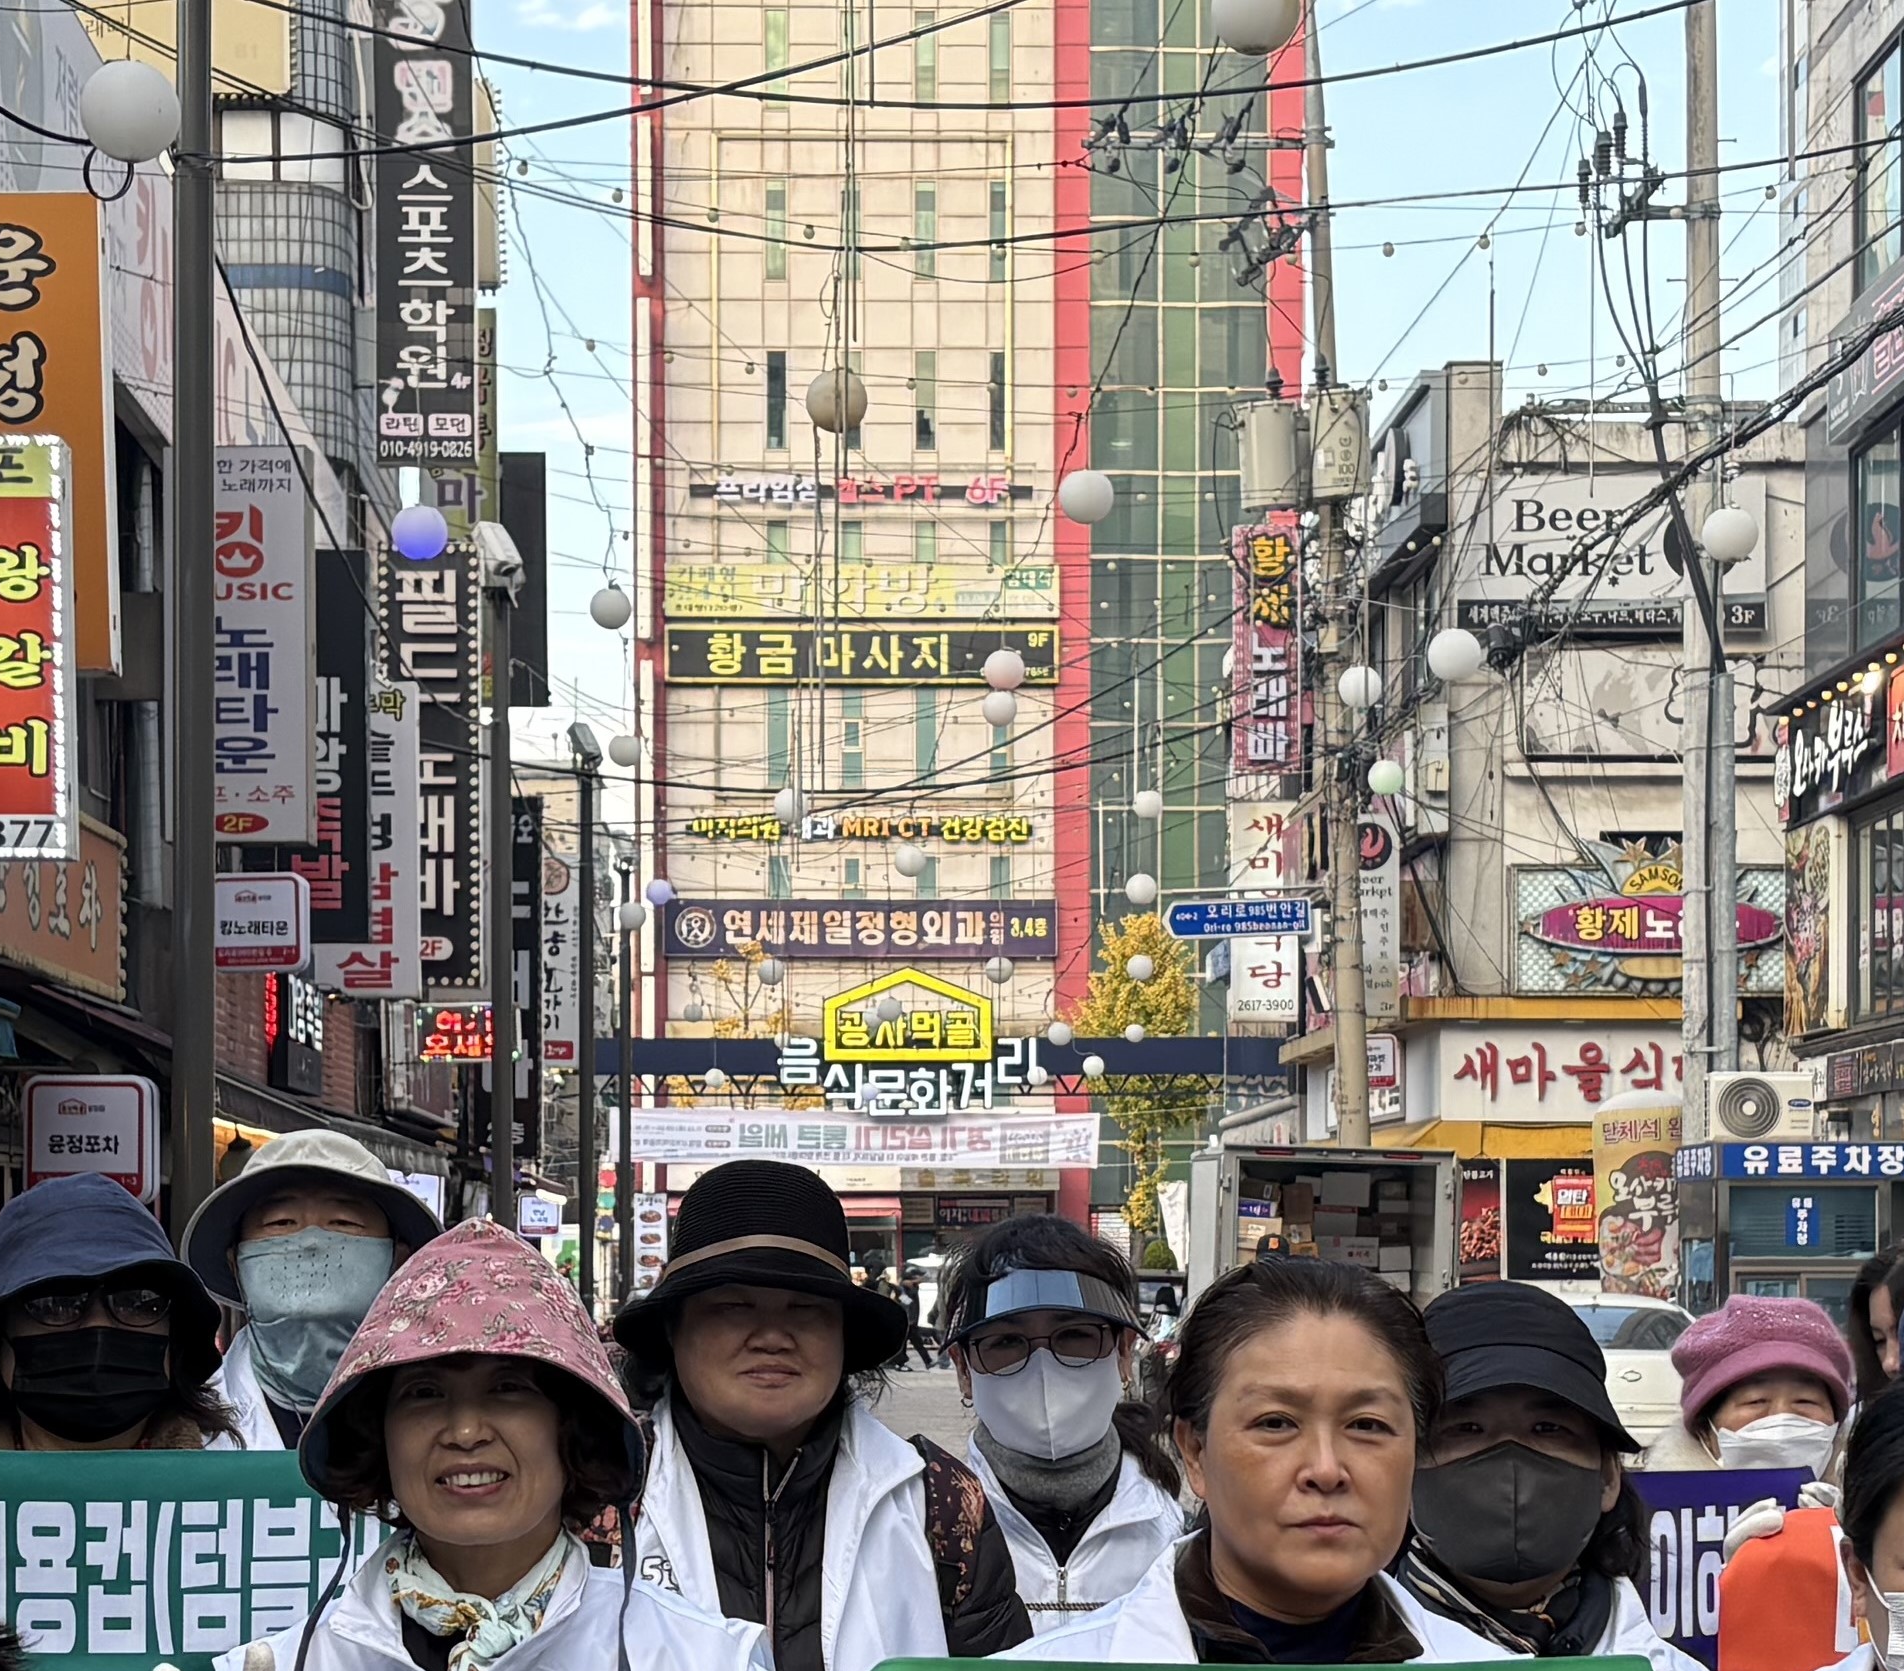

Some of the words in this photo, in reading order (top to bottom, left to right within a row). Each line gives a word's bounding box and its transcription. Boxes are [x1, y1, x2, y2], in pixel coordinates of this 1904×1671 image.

[380, 438, 473, 458] 010-4919-0826
[239, 458, 293, 475] 가격에
[221, 478, 292, 494] 노래까지
[893, 475, 939, 504] PT
[965, 475, 1010, 504] 6F
[1511, 498, 1626, 534] Beer
[1481, 543, 1656, 577] Market
[1730, 606, 1756, 624] 3F
[706, 632, 798, 676] 황금
[815, 632, 949, 676] 마사지
[1027, 632, 1049, 648] 9F
[215, 615, 280, 774] 노래타운
[247, 784, 295, 804] 소주
[222, 813, 253, 832] 2F
[841, 817, 892, 839] MRI
[896, 817, 932, 839] CT
[940, 815, 1031, 842] 건강검진
[219, 920, 289, 937] 킹노래타운
[721, 909, 987, 947] 연세제일정형외과
[1574, 904, 1640, 942] 황제
[1237, 999, 1295, 1012] 2617-3900
[777, 1036, 1038, 1117] 음식문화거리
[1453, 1041, 1684, 1104] 새마을식
[1601, 1116, 1662, 1145] 단체석
[47, 1134, 120, 1156] 윤정포차
[1676, 1146, 1712, 1180] 유료주차장
